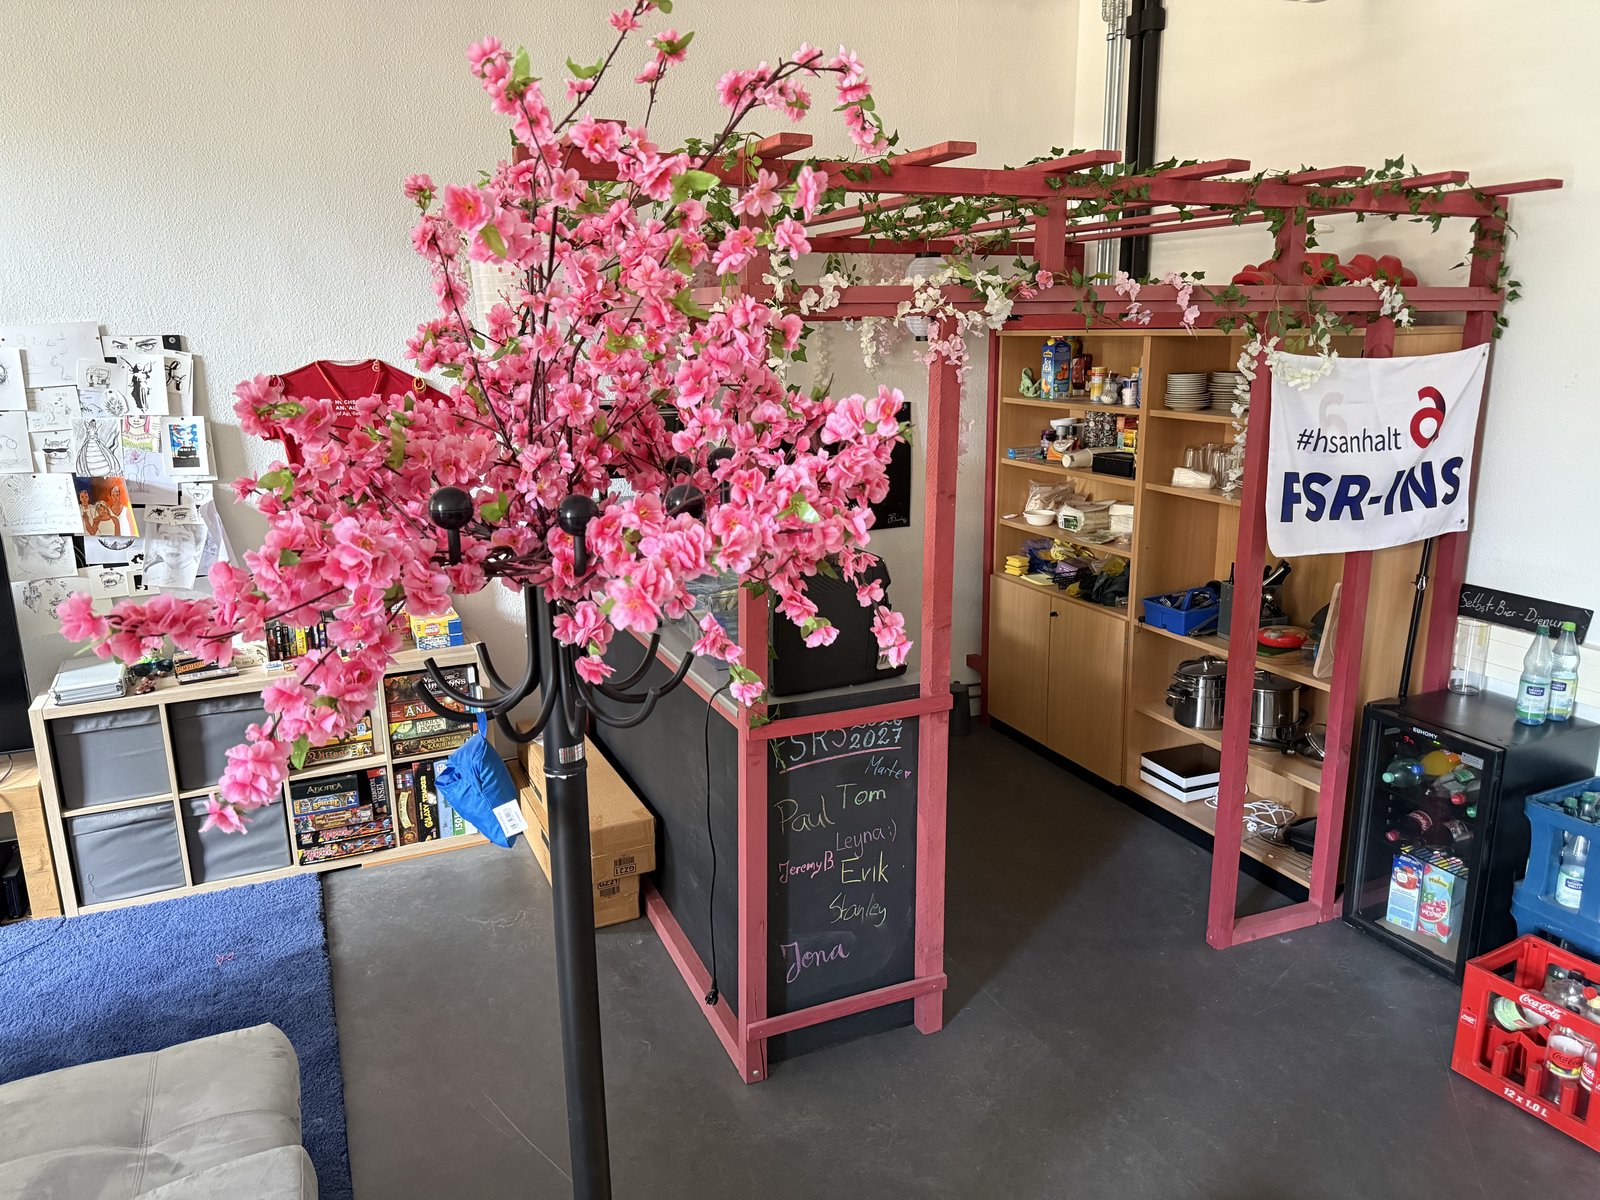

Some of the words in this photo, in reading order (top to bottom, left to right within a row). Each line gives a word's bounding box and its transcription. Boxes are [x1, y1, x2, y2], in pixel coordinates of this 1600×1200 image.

[1297, 427, 1402, 453] #hsanhalt
[1280, 456, 1464, 523] FSR-INS
[848, 726, 902, 749] 2027
[1412, 726, 1438, 740] EUHOMY
[836, 783, 887, 809] Tom
[774, 795, 835, 836] Paul
[780, 942, 850, 984] Jona
[1519, 994, 1562, 1020] Coca-Cola
[1503, 1087, 1515, 1099] 12
[1525, 1100, 1541, 1112] 1.0
[1541, 1108, 1548, 1118] L
